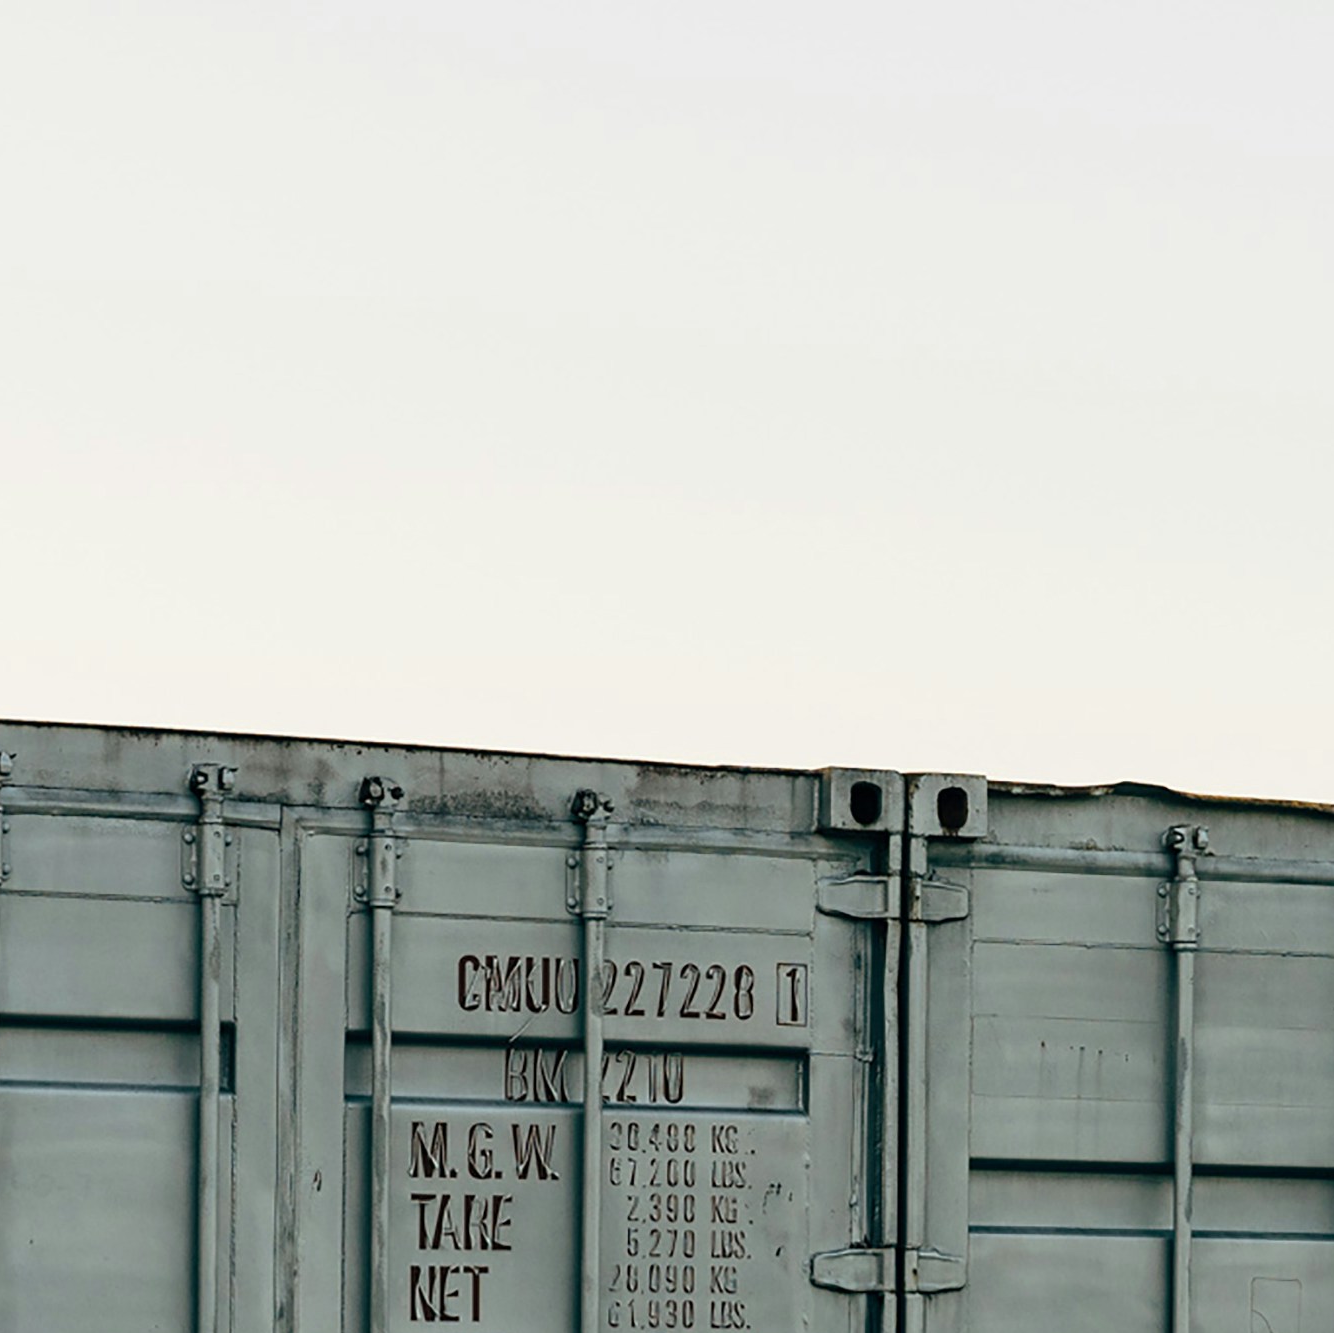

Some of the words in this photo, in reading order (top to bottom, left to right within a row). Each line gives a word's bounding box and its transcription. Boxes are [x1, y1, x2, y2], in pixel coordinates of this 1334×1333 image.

[601, 959, 755, 1021] 227228
[410, 1192, 513, 1251] TARE
[410, 1264, 490, 1322] NET
